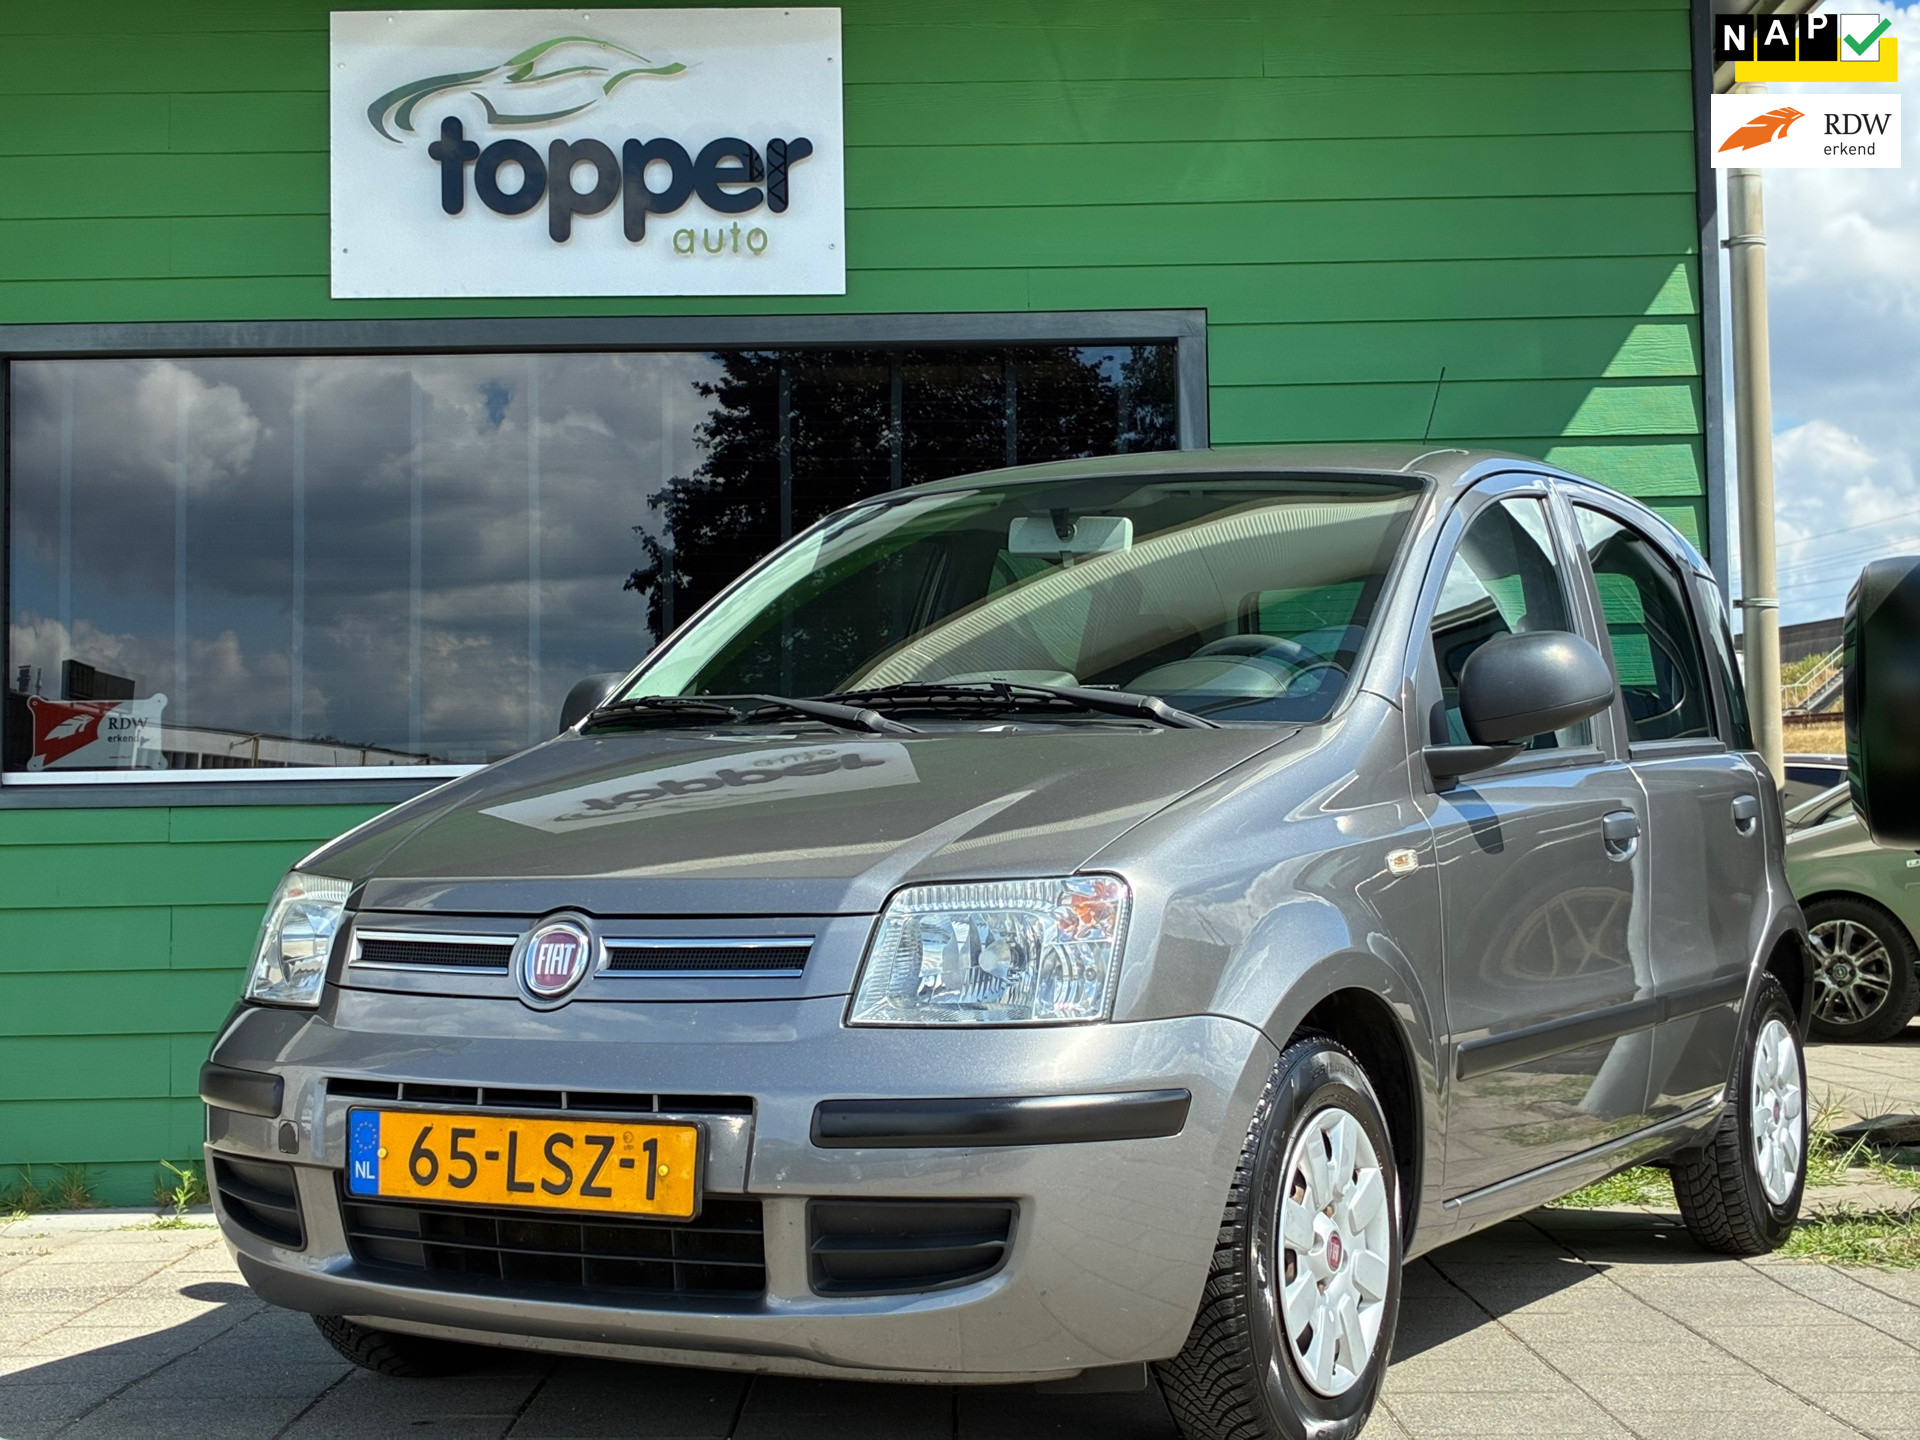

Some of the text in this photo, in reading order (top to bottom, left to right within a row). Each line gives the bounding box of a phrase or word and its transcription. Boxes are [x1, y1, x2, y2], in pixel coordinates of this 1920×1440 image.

[427, 115, 814, 244] topper
[672, 221, 769, 257] auto
[107, 717, 149, 730] RDW
[536, 943, 577, 976] FIAT
[354, 1160, 376, 1180] NL
[408, 1125, 660, 1201] 65-LSZ-1
